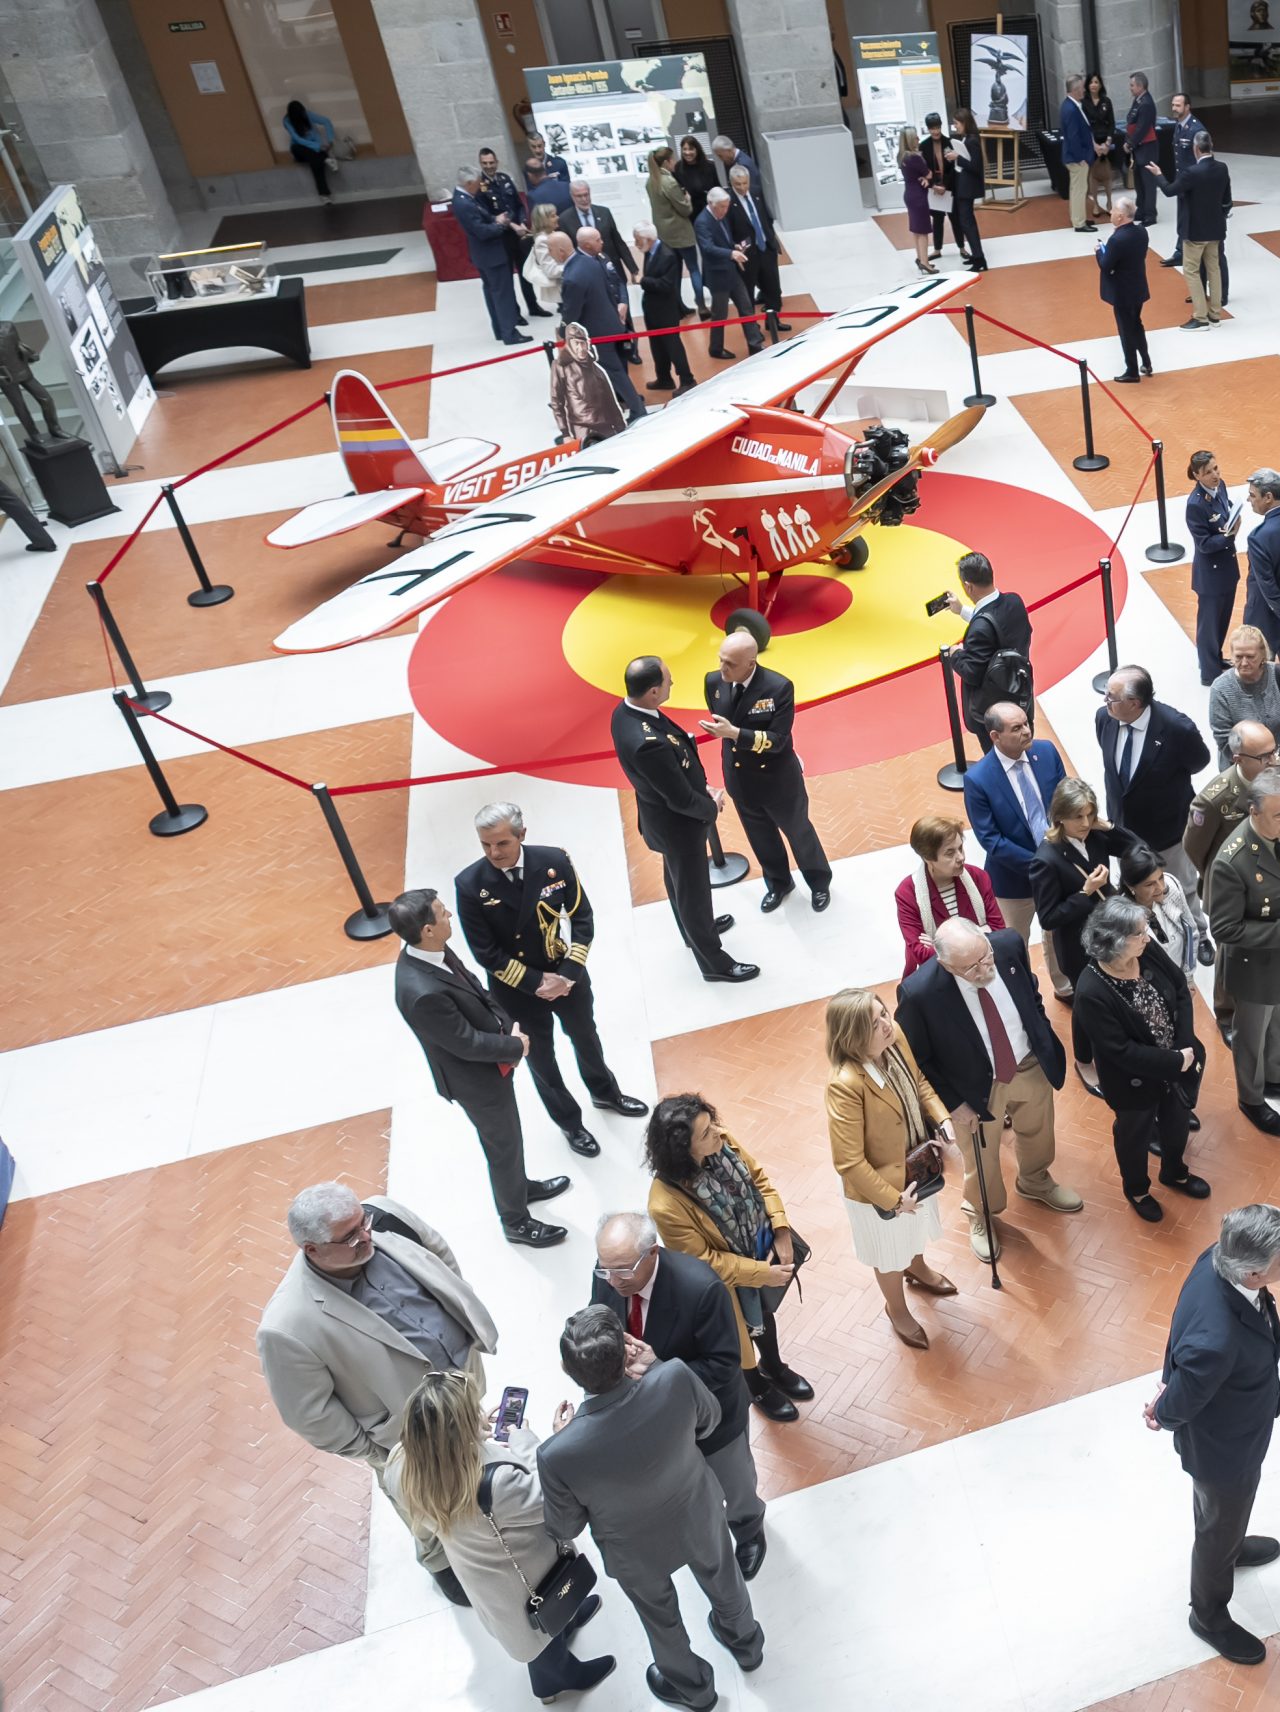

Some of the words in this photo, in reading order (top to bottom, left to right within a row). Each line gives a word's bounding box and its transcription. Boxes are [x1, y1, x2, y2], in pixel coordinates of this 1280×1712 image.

[443, 471, 498, 505] VISIT
[502, 451, 577, 491] SPA
[731, 436, 772, 462] CIUDAD
[776, 448, 819, 476] MANILA
